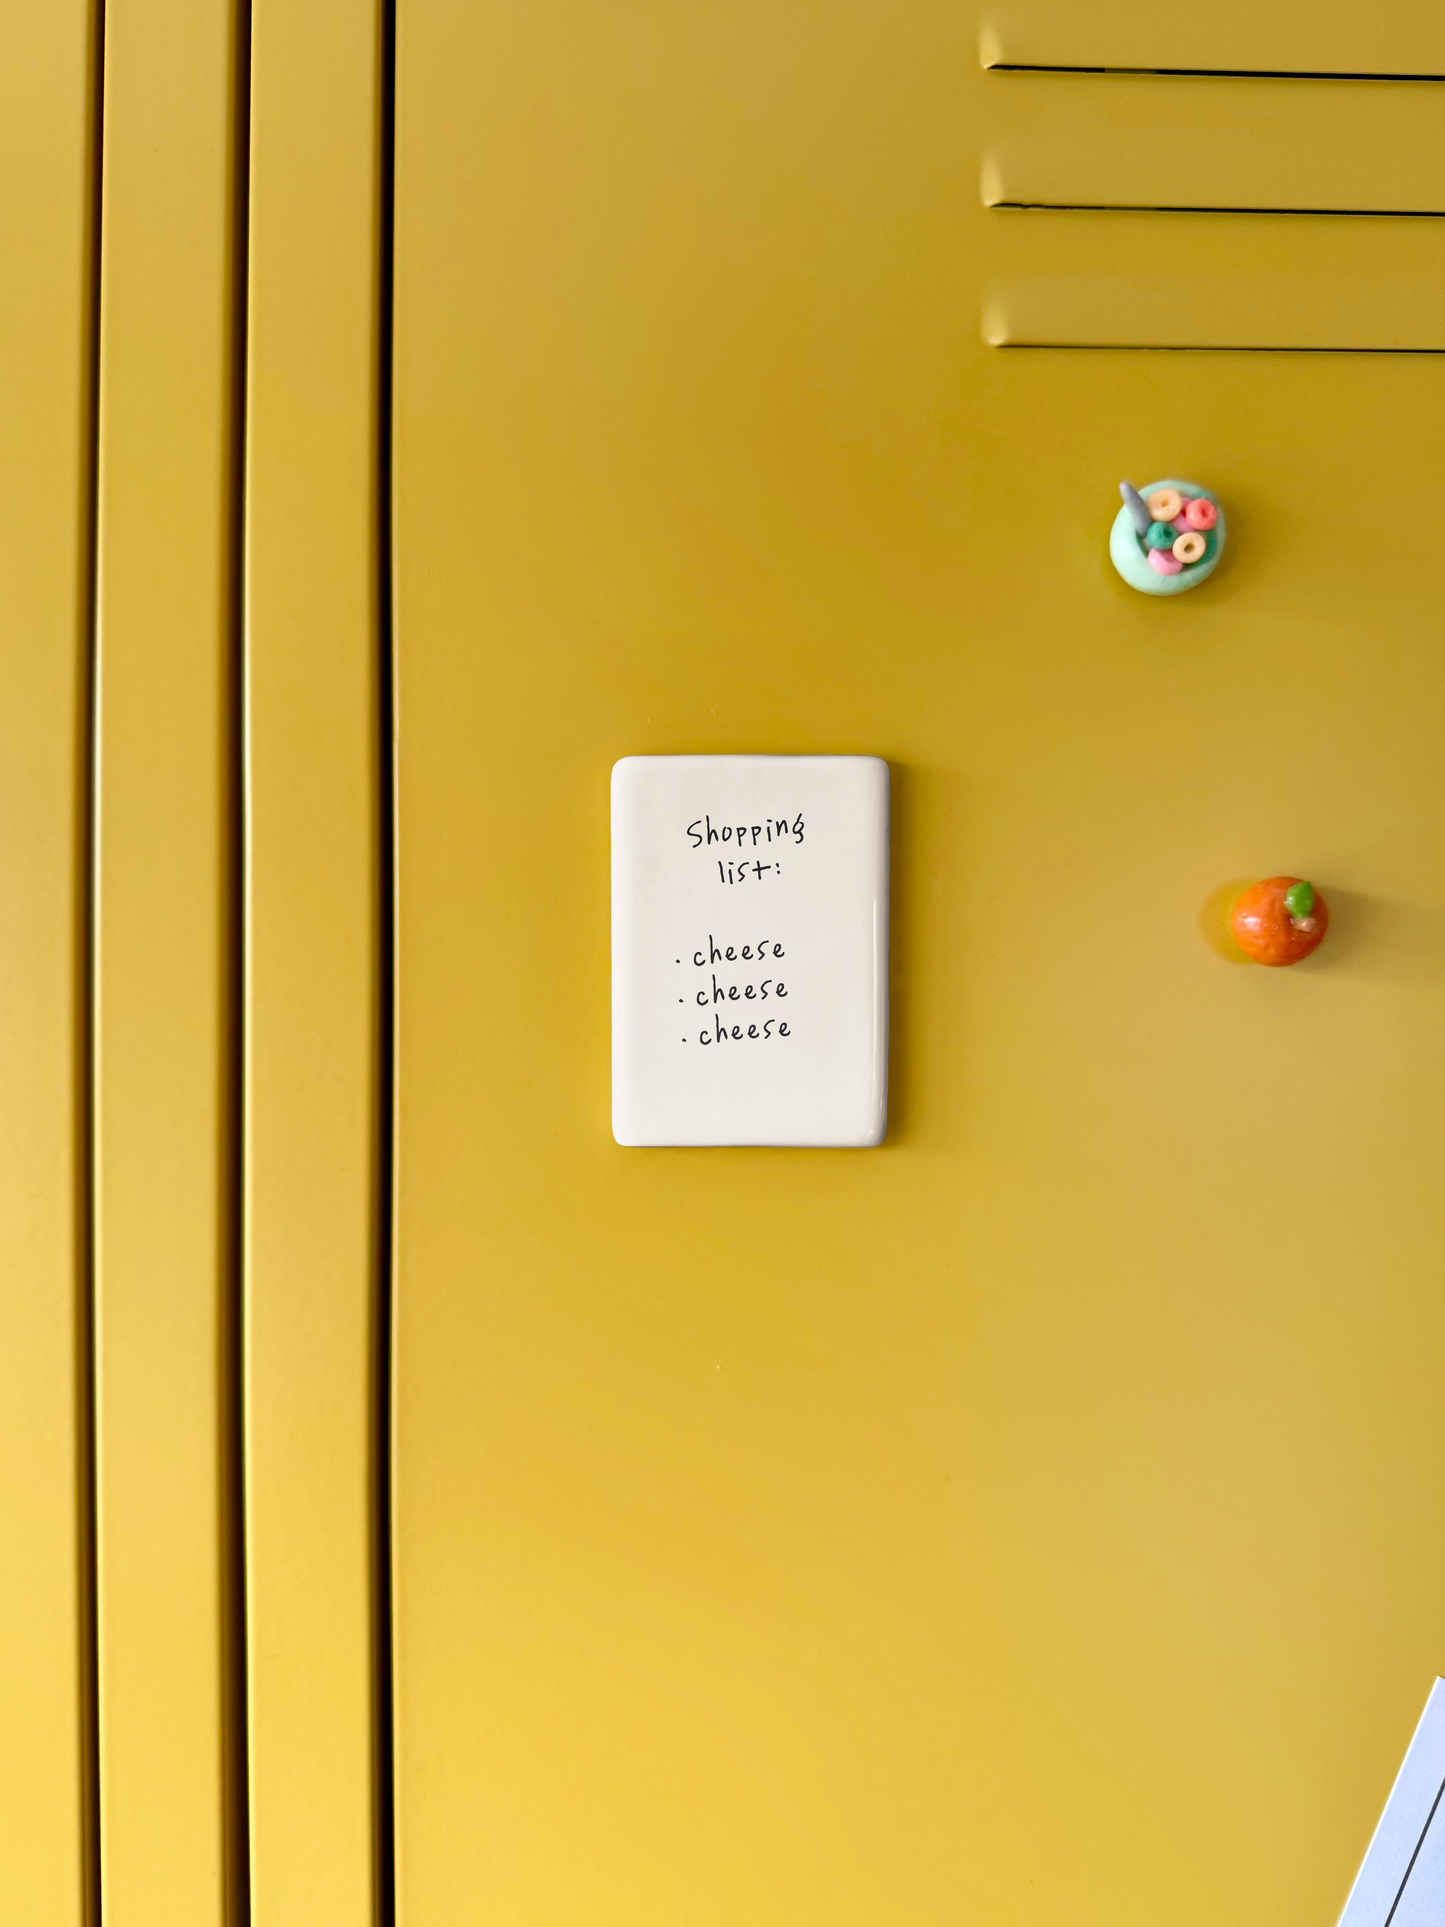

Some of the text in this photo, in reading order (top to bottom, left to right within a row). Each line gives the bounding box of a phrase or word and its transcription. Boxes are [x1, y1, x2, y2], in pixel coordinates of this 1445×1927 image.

[686, 812, 805, 849] Shopping
[717, 860, 781, 885] list:
[693, 934, 786, 967] cheese
[696, 973, 789, 1007] cheese
[699, 1013, 792, 1046] cheese
